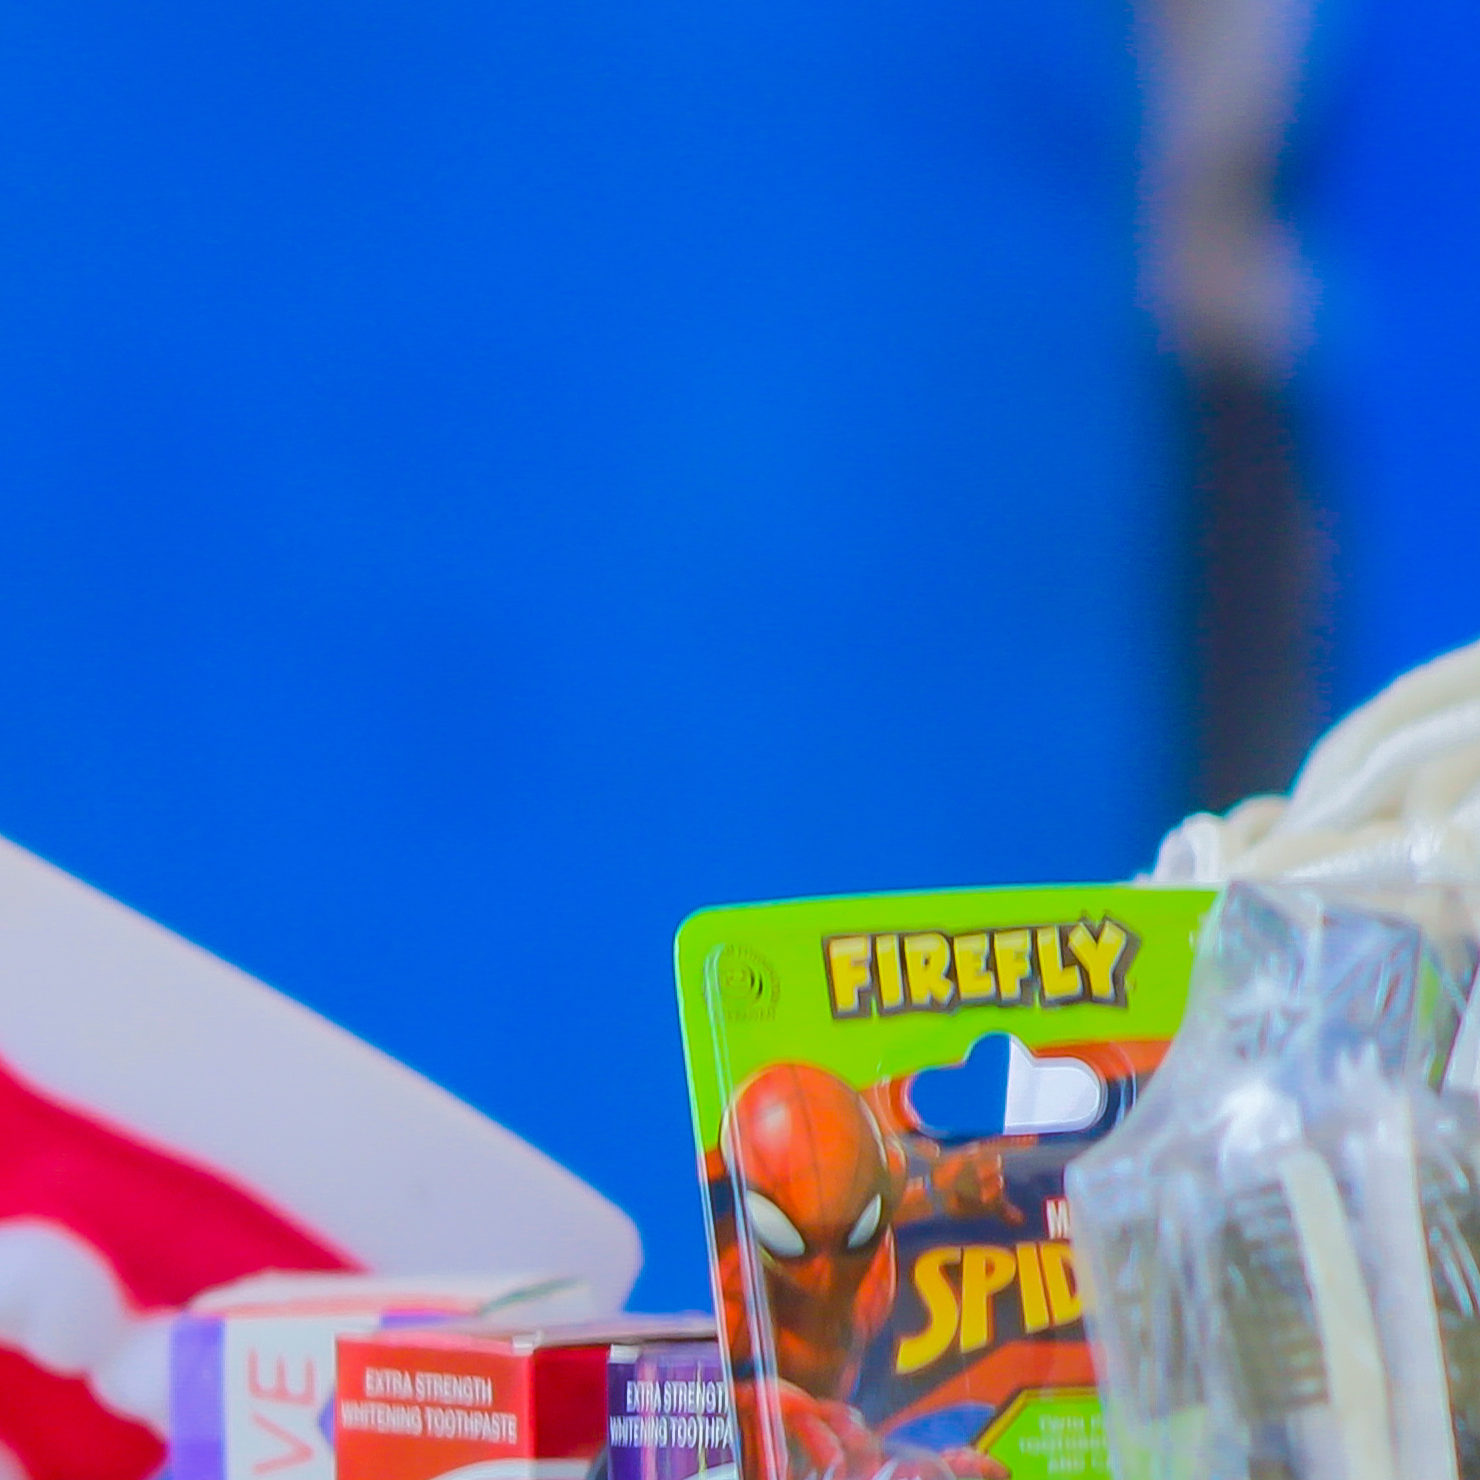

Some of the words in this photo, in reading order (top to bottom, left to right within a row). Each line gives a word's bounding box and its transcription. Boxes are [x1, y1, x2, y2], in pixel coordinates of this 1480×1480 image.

[824, 914, 1140, 1019] FIREFLY
[365, 1366, 412, 1399] EXTRA
[416, 1371, 493, 1407] STRENGTH
[626, 1380, 659, 1412] EXTRA
[341, 1400, 423, 1435] WHITENING
[426, 1405, 518, 1444] TOOTHPASTE
[610, 1415, 668, 1448] WHITENING
